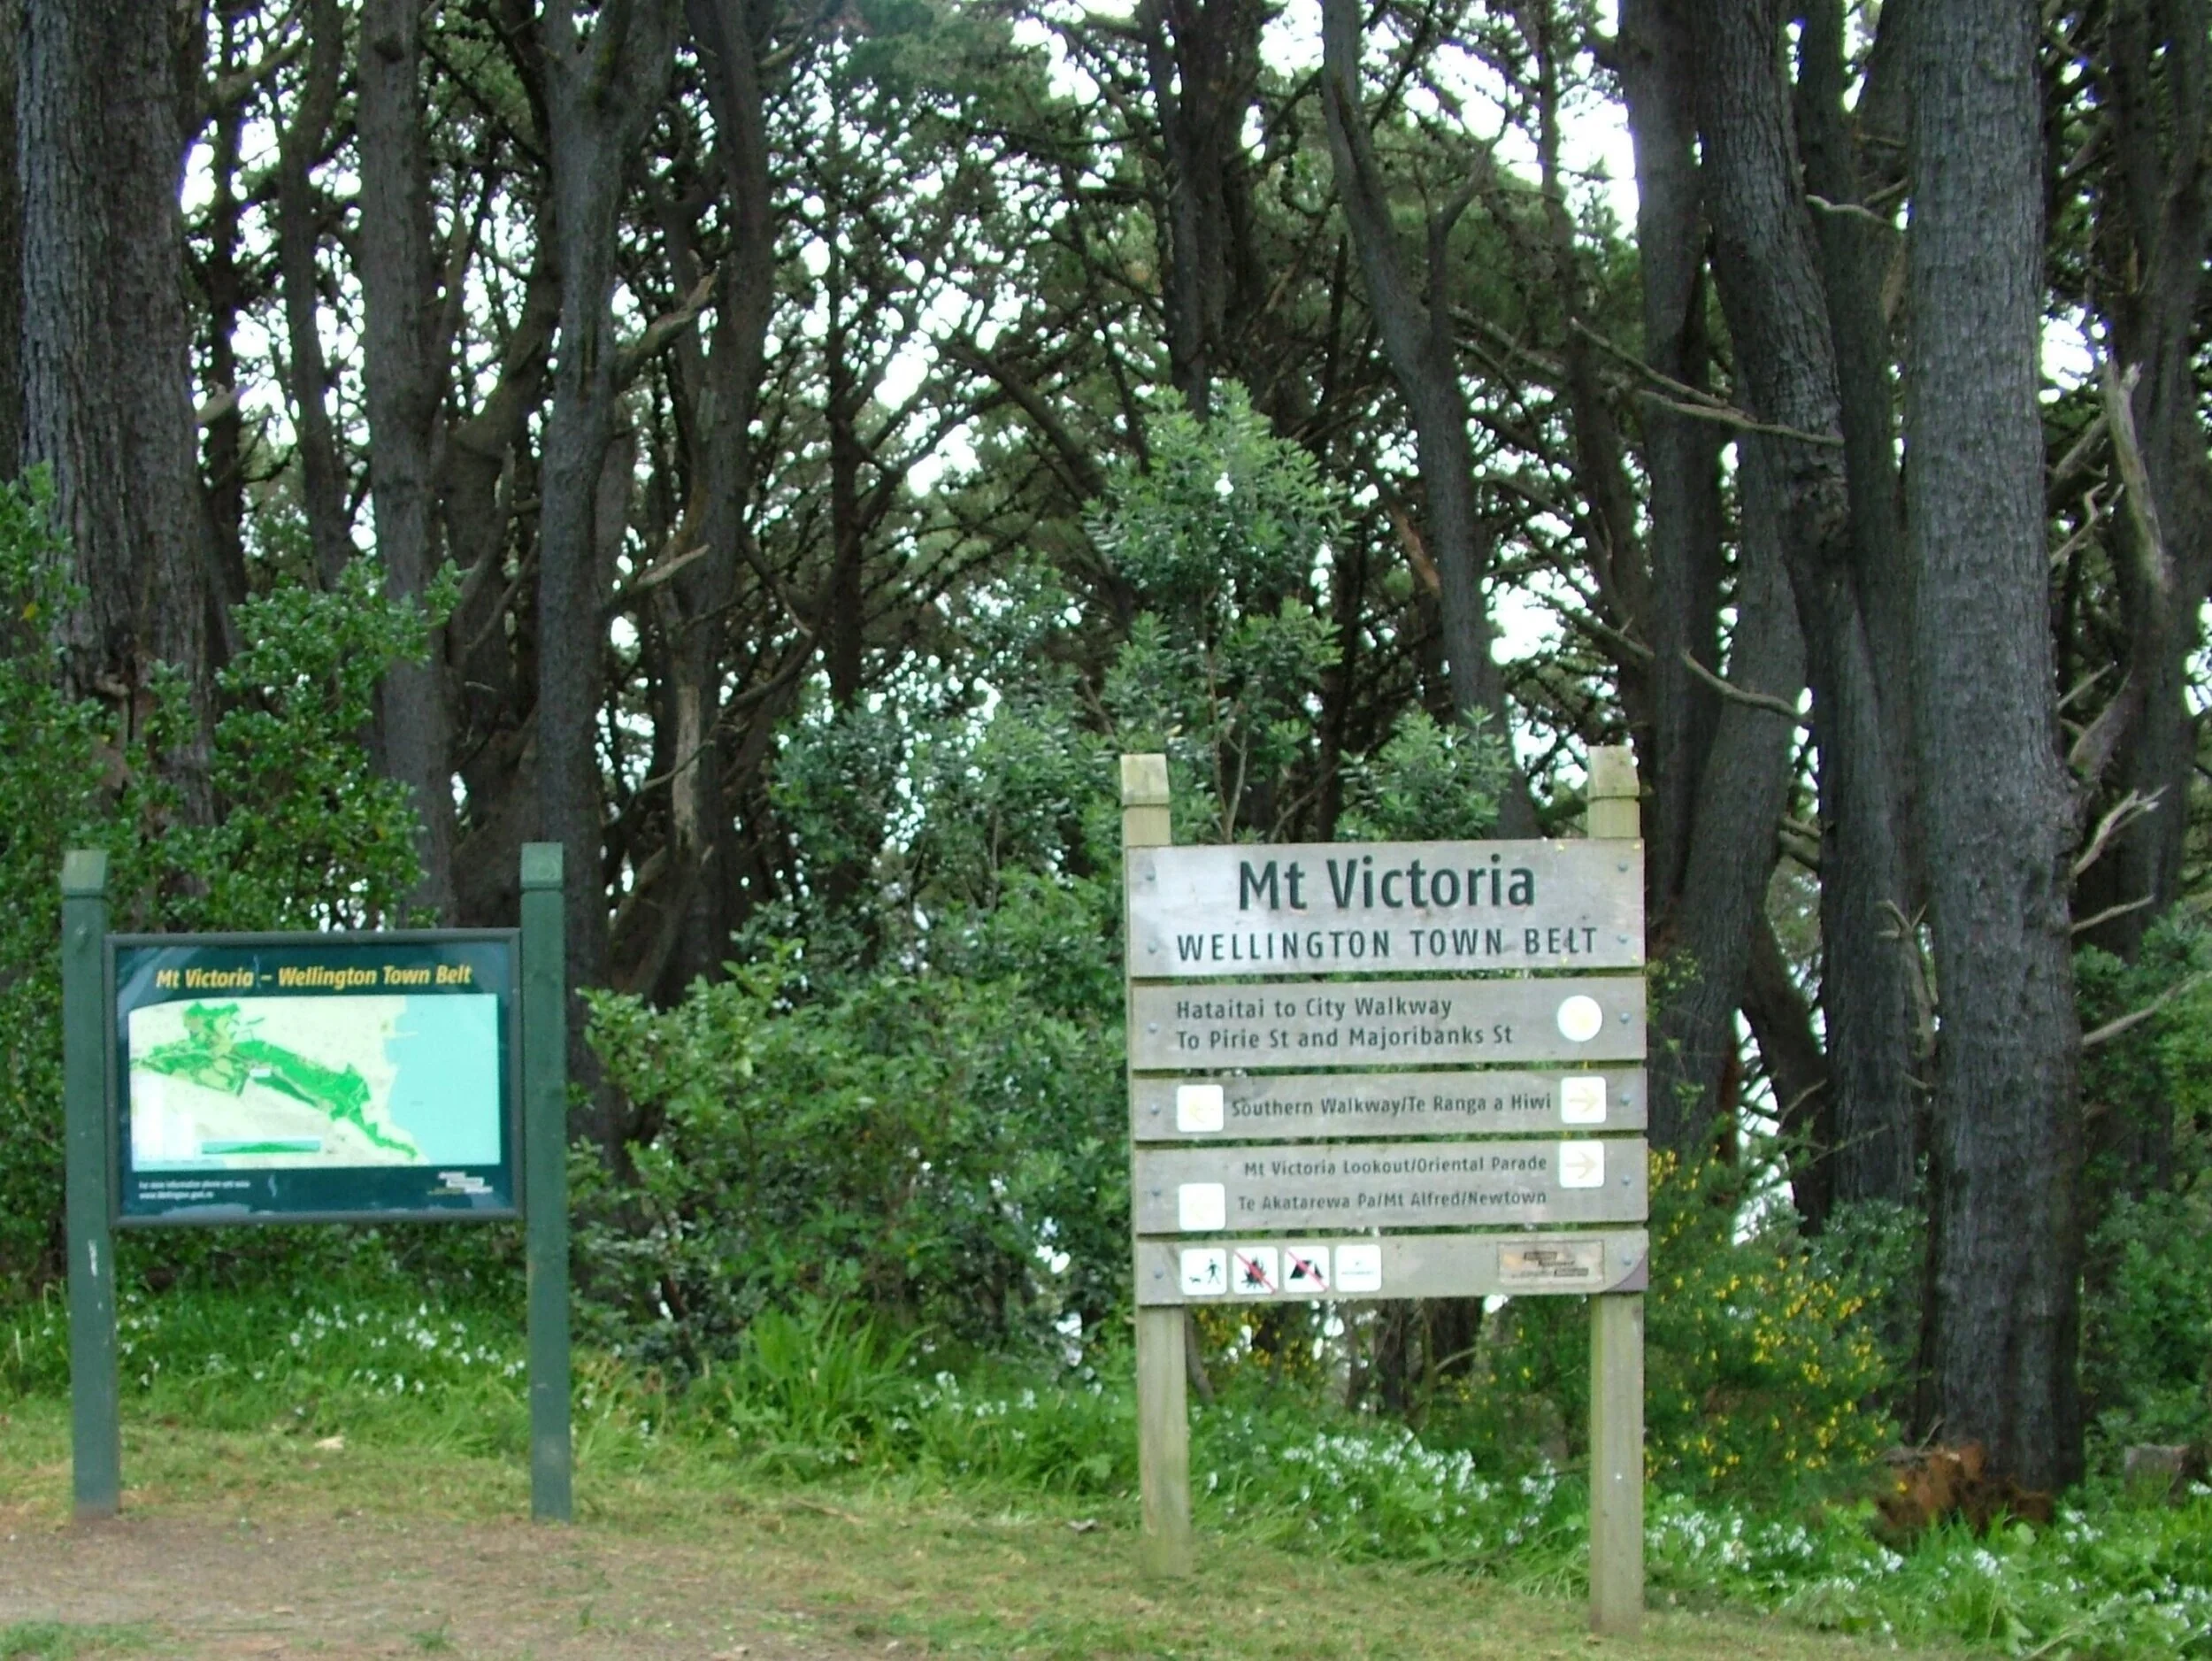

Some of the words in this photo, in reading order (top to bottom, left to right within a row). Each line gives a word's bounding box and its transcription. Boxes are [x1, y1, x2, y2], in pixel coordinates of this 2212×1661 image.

[1238, 859, 1307, 911] Mt
[1326, 853, 1536, 910] Victoria
[1177, 929, 1390, 961] WELLINGTON
[1411, 927, 1502, 957] TOWN
[1525, 927, 1598, 954] BELT
[156, 969, 180, 988] Mt
[185, 967, 254, 988] Victoria
[279, 966, 377, 990] Wellington
[383, 965, 430, 984] Town
[435, 964, 472, 984] Belt
[1177, 998, 1264, 1019] Hataitai
[1274, 1000, 1296, 1017] to
[1306, 997, 1346, 1020] City
[1356, 996, 1452, 1019] Walkway
[1177, 1030, 1200, 1050] To
[1210, 1028, 1260, 1050] Pirie
[1270, 1028, 1289, 1048] St
[1298, 1028, 1339, 1047] and
[1349, 1026, 1484, 1050] Majoribanks
[1494, 1025, 1513, 1044] St
[1232, 1098, 1313, 1117] Southern
[1433, 1095, 1486, 1115] Ranga
[1494, 1097, 1503, 1111] a
[1511, 1093, 1551, 1110] Hiwi
[1245, 1162, 1263, 1176] Mt
[1271, 1159, 1336, 1176] Victoria
[1492, 1156, 1547, 1171] Parade
[1239, 1196, 1256, 1211] Te
